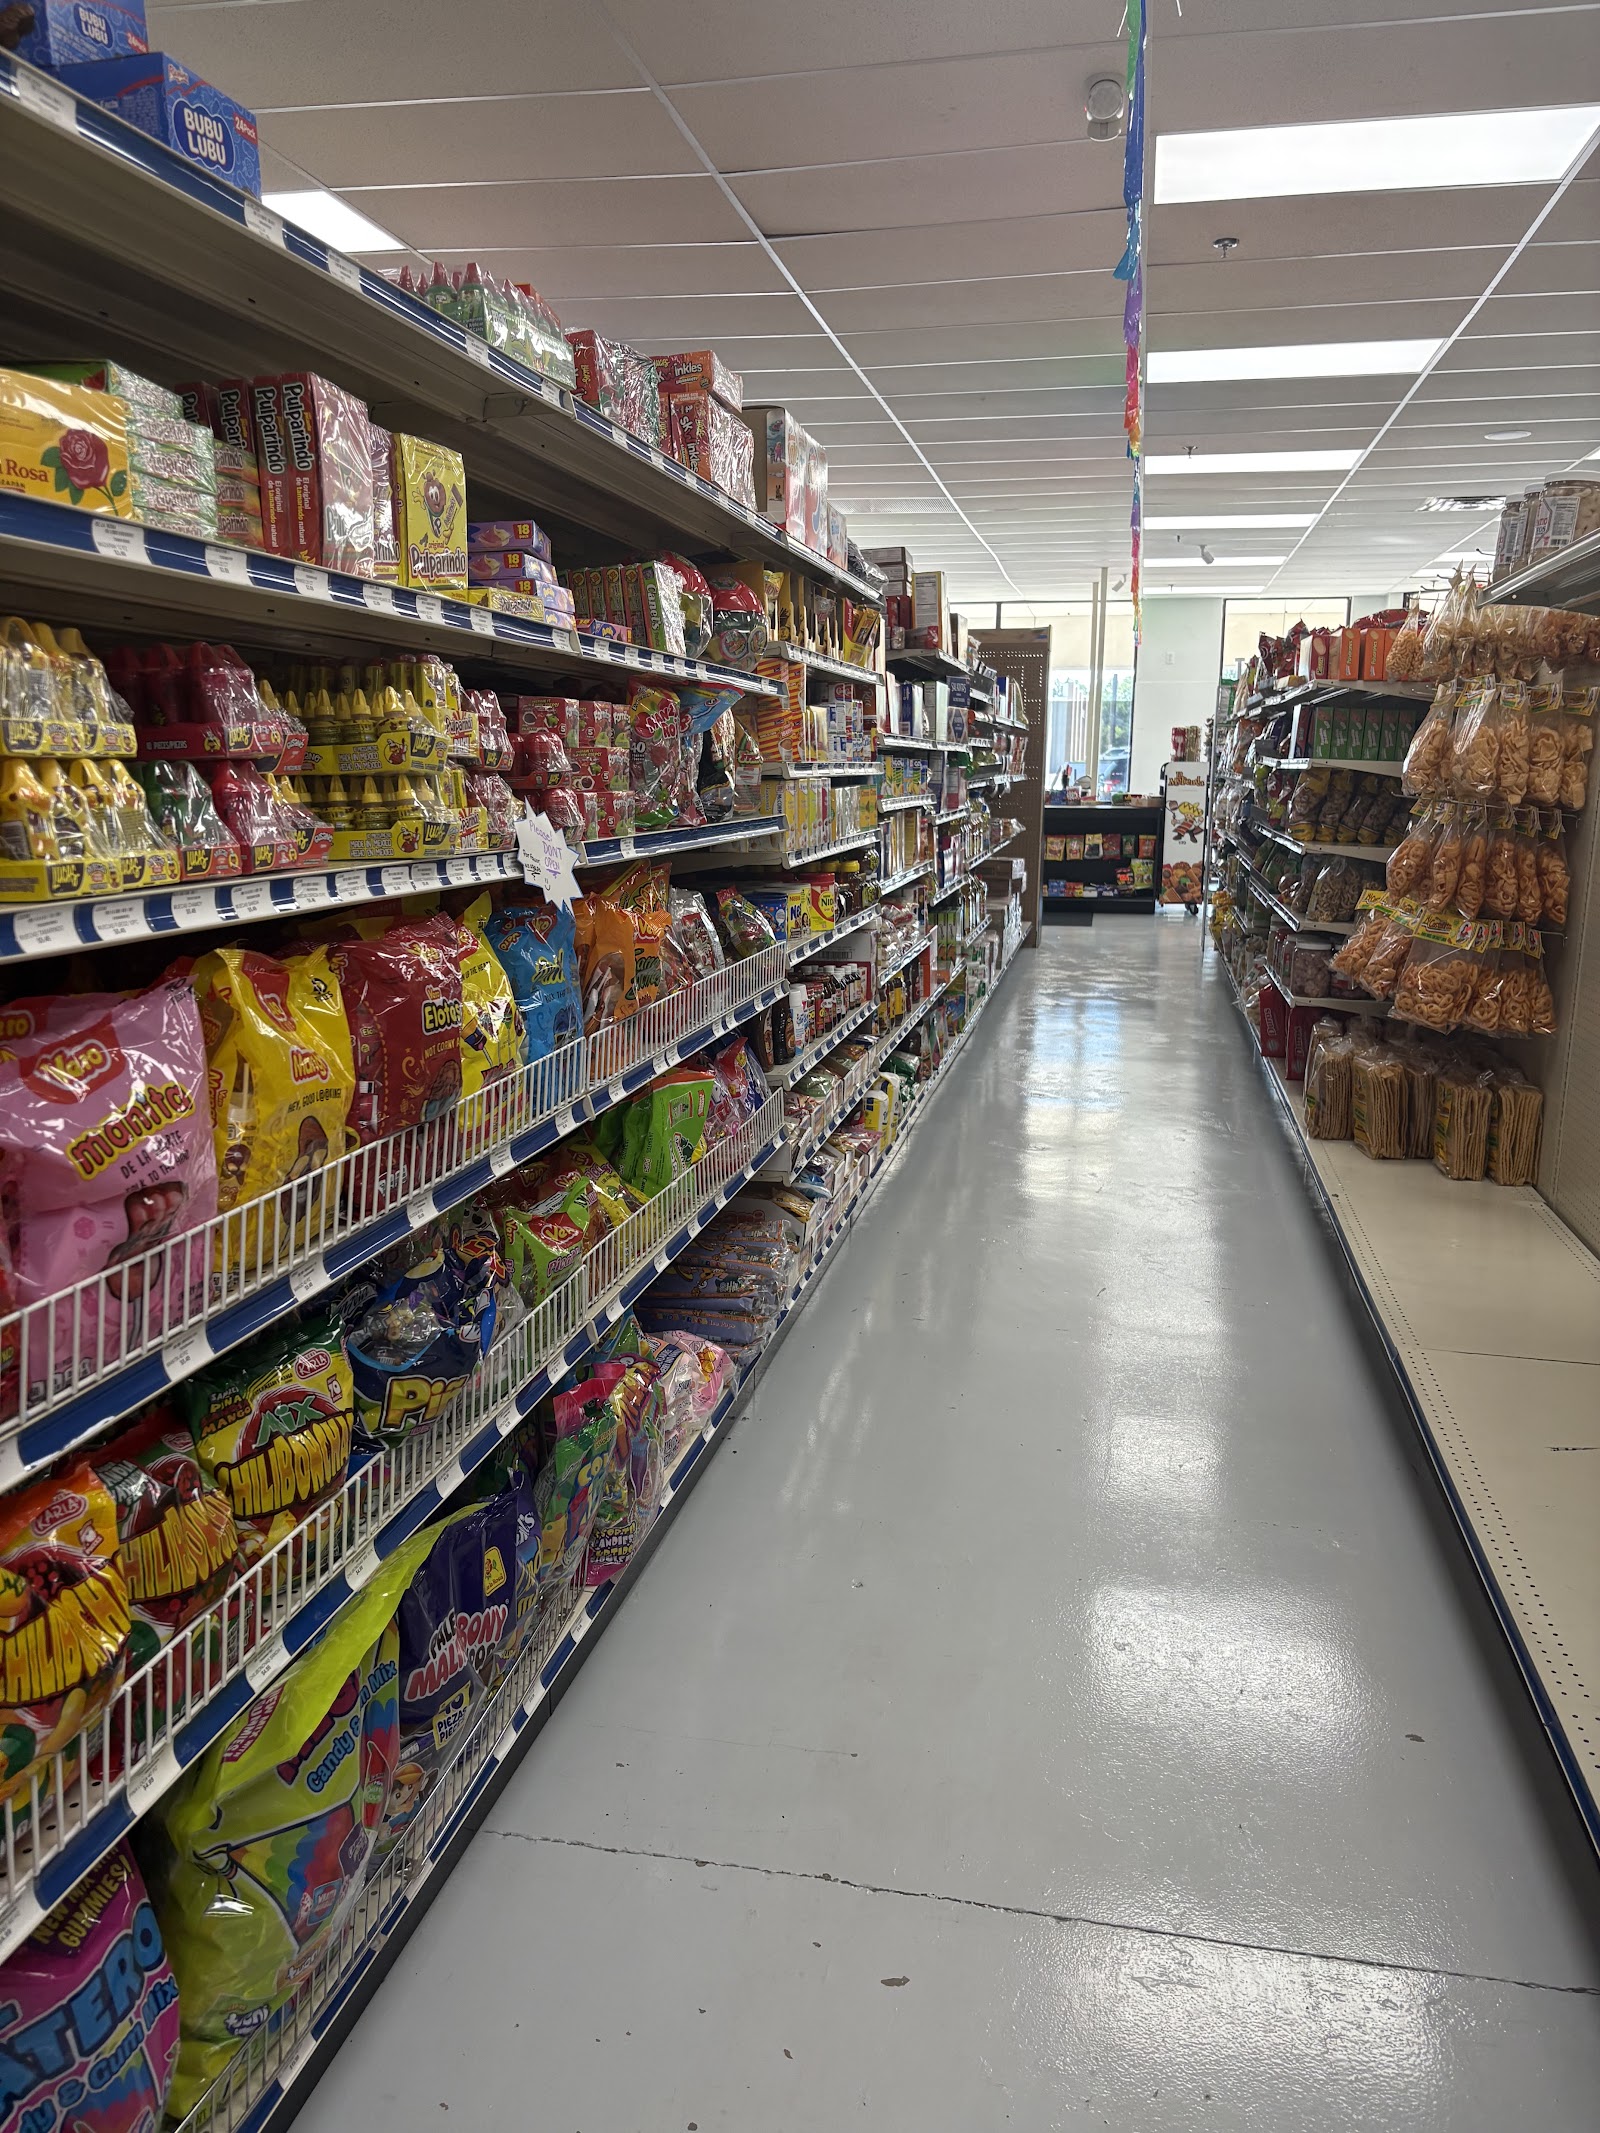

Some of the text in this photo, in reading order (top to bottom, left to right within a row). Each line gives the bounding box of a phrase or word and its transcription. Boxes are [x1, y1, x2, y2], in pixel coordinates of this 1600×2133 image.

[79, 7, 106, 31] BUBU
[81, 23, 108, 45] LUBU
[183, 107, 223, 142] BUBU
[187, 130, 226, 165] LUBU
[255, 386, 285, 475] Pulparindo
[282, 382, 314, 472] Pulparindo
[6, 458, 49, 483] Rosa
[517, 523, 530, 535] 18
[410, 545, 467, 577] Pulparindo
[507, 553, 520, 564] 18
[518, 580, 531, 591] 18
[424, 1002, 462, 1030] Elotes
[70, 1085, 193, 1175] manita
[121, 1152, 152, 1180] DE LA
[201, 1406, 251, 1437] MANGO
[35, 1498, 83, 1531] KARLA
[306, 1729, 355, 1794] Candy
[367, 1660, 398, 1696] Mix
[437, 1706, 467, 1732] PIEZAS
[32, 1874, 94, 1945] NEW MIX
[57, 1854, 136, 1948] GUMMIES!
[87, 2021, 145, 2091] Gum
[142, 1974, 180, 2033] Mix
